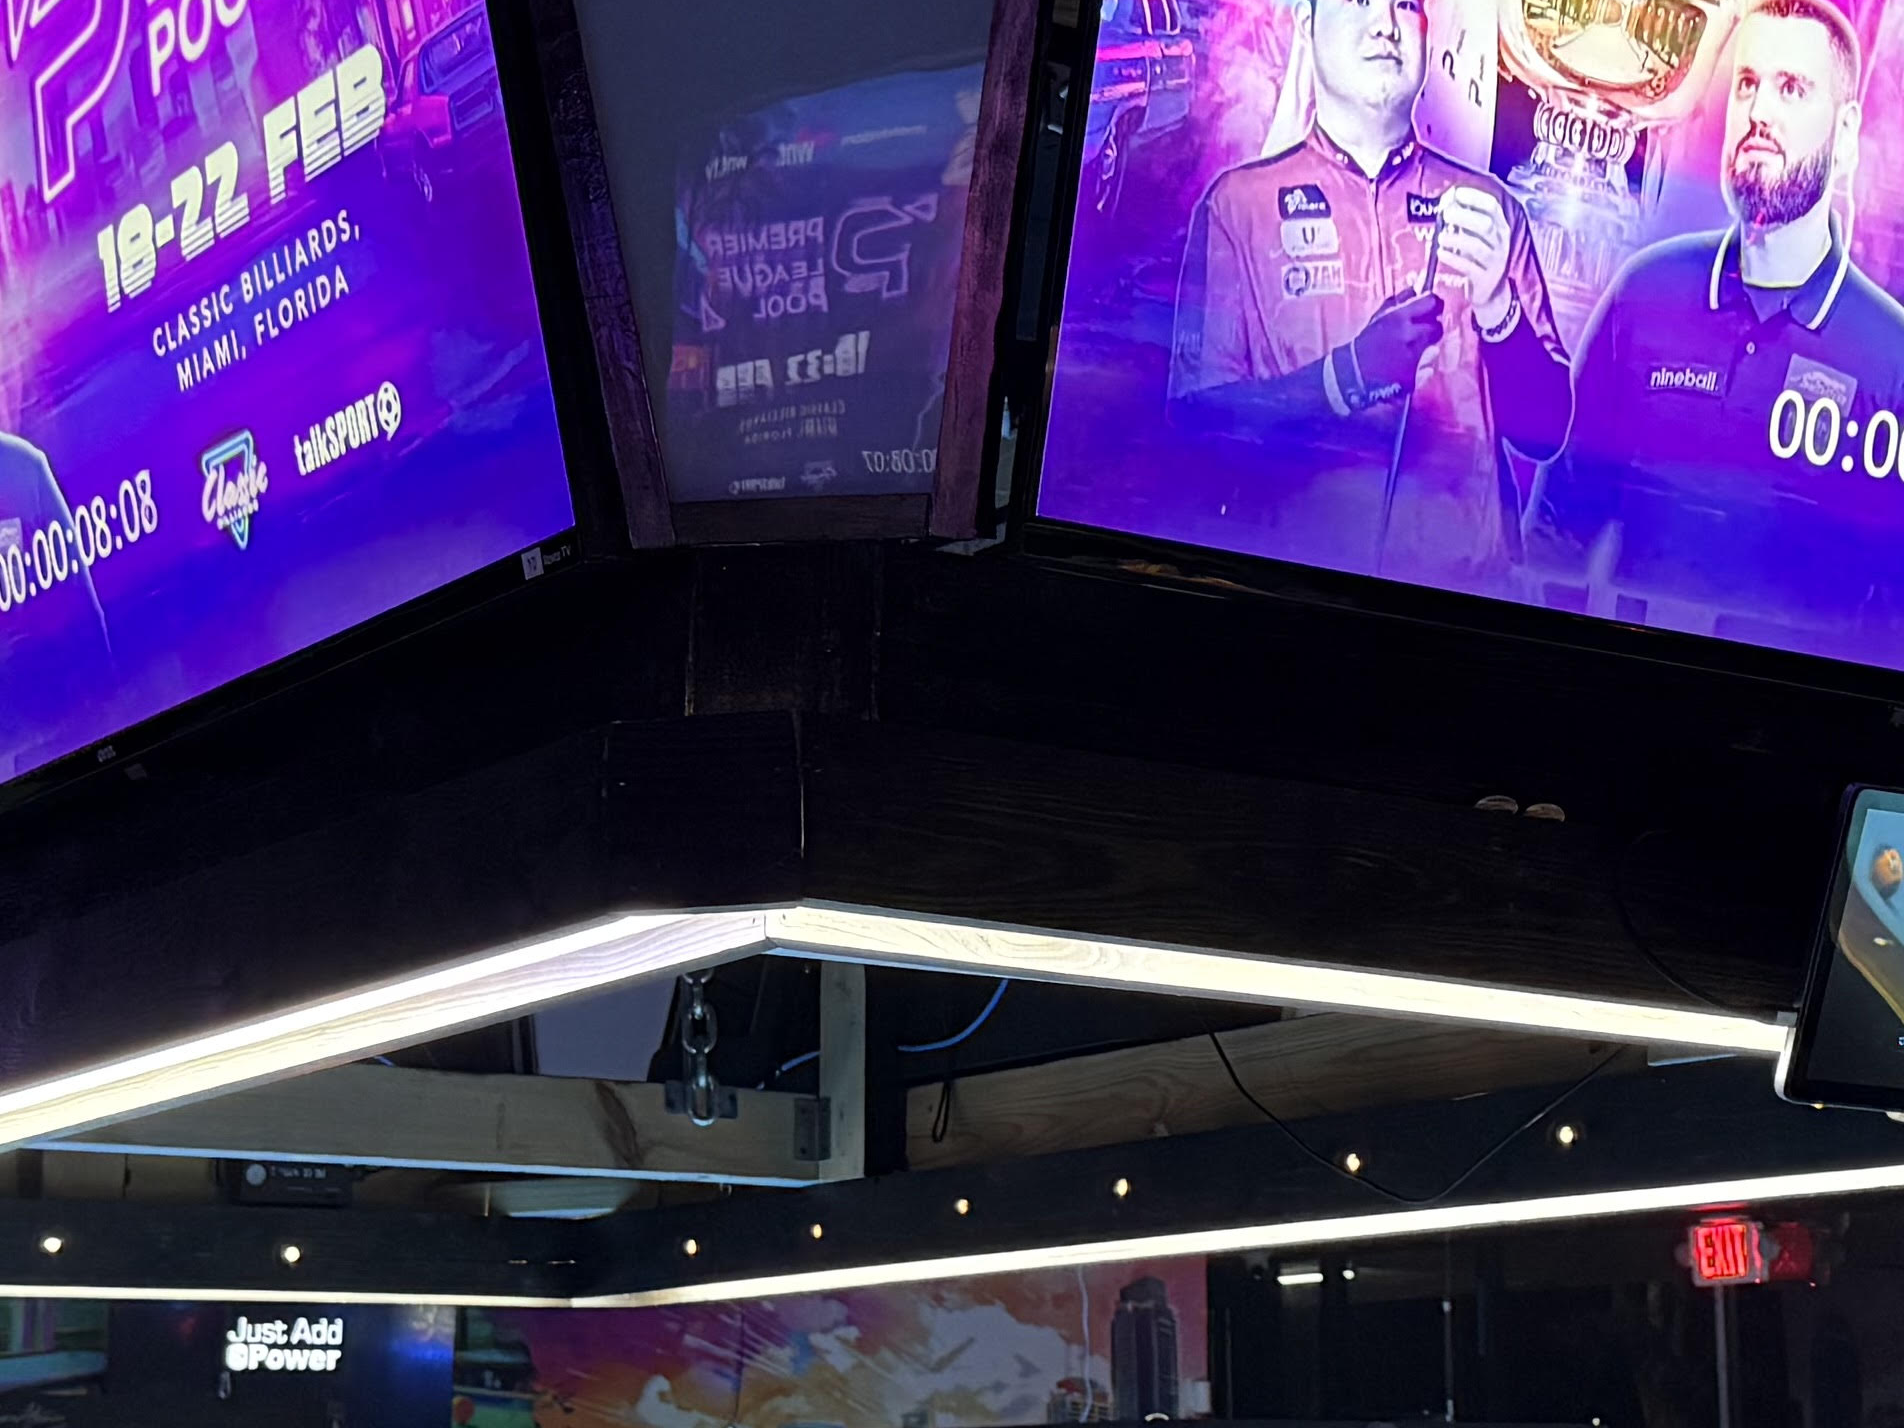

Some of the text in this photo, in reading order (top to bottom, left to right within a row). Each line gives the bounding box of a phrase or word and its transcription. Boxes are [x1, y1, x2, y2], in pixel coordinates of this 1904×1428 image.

[97, 43, 386, 314] 18-22 FEB
[152, 209, 361, 357] CLASSIC BILLIARDS,
[176, 264, 350, 392] MIAMI, FLORIDA
[294, 394, 380, 477] talkSPORT
[201, 454, 269, 523] Classic
[1697, 1223, 1747, 1279] EXIT
[226, 1316, 344, 1345] Just Add
